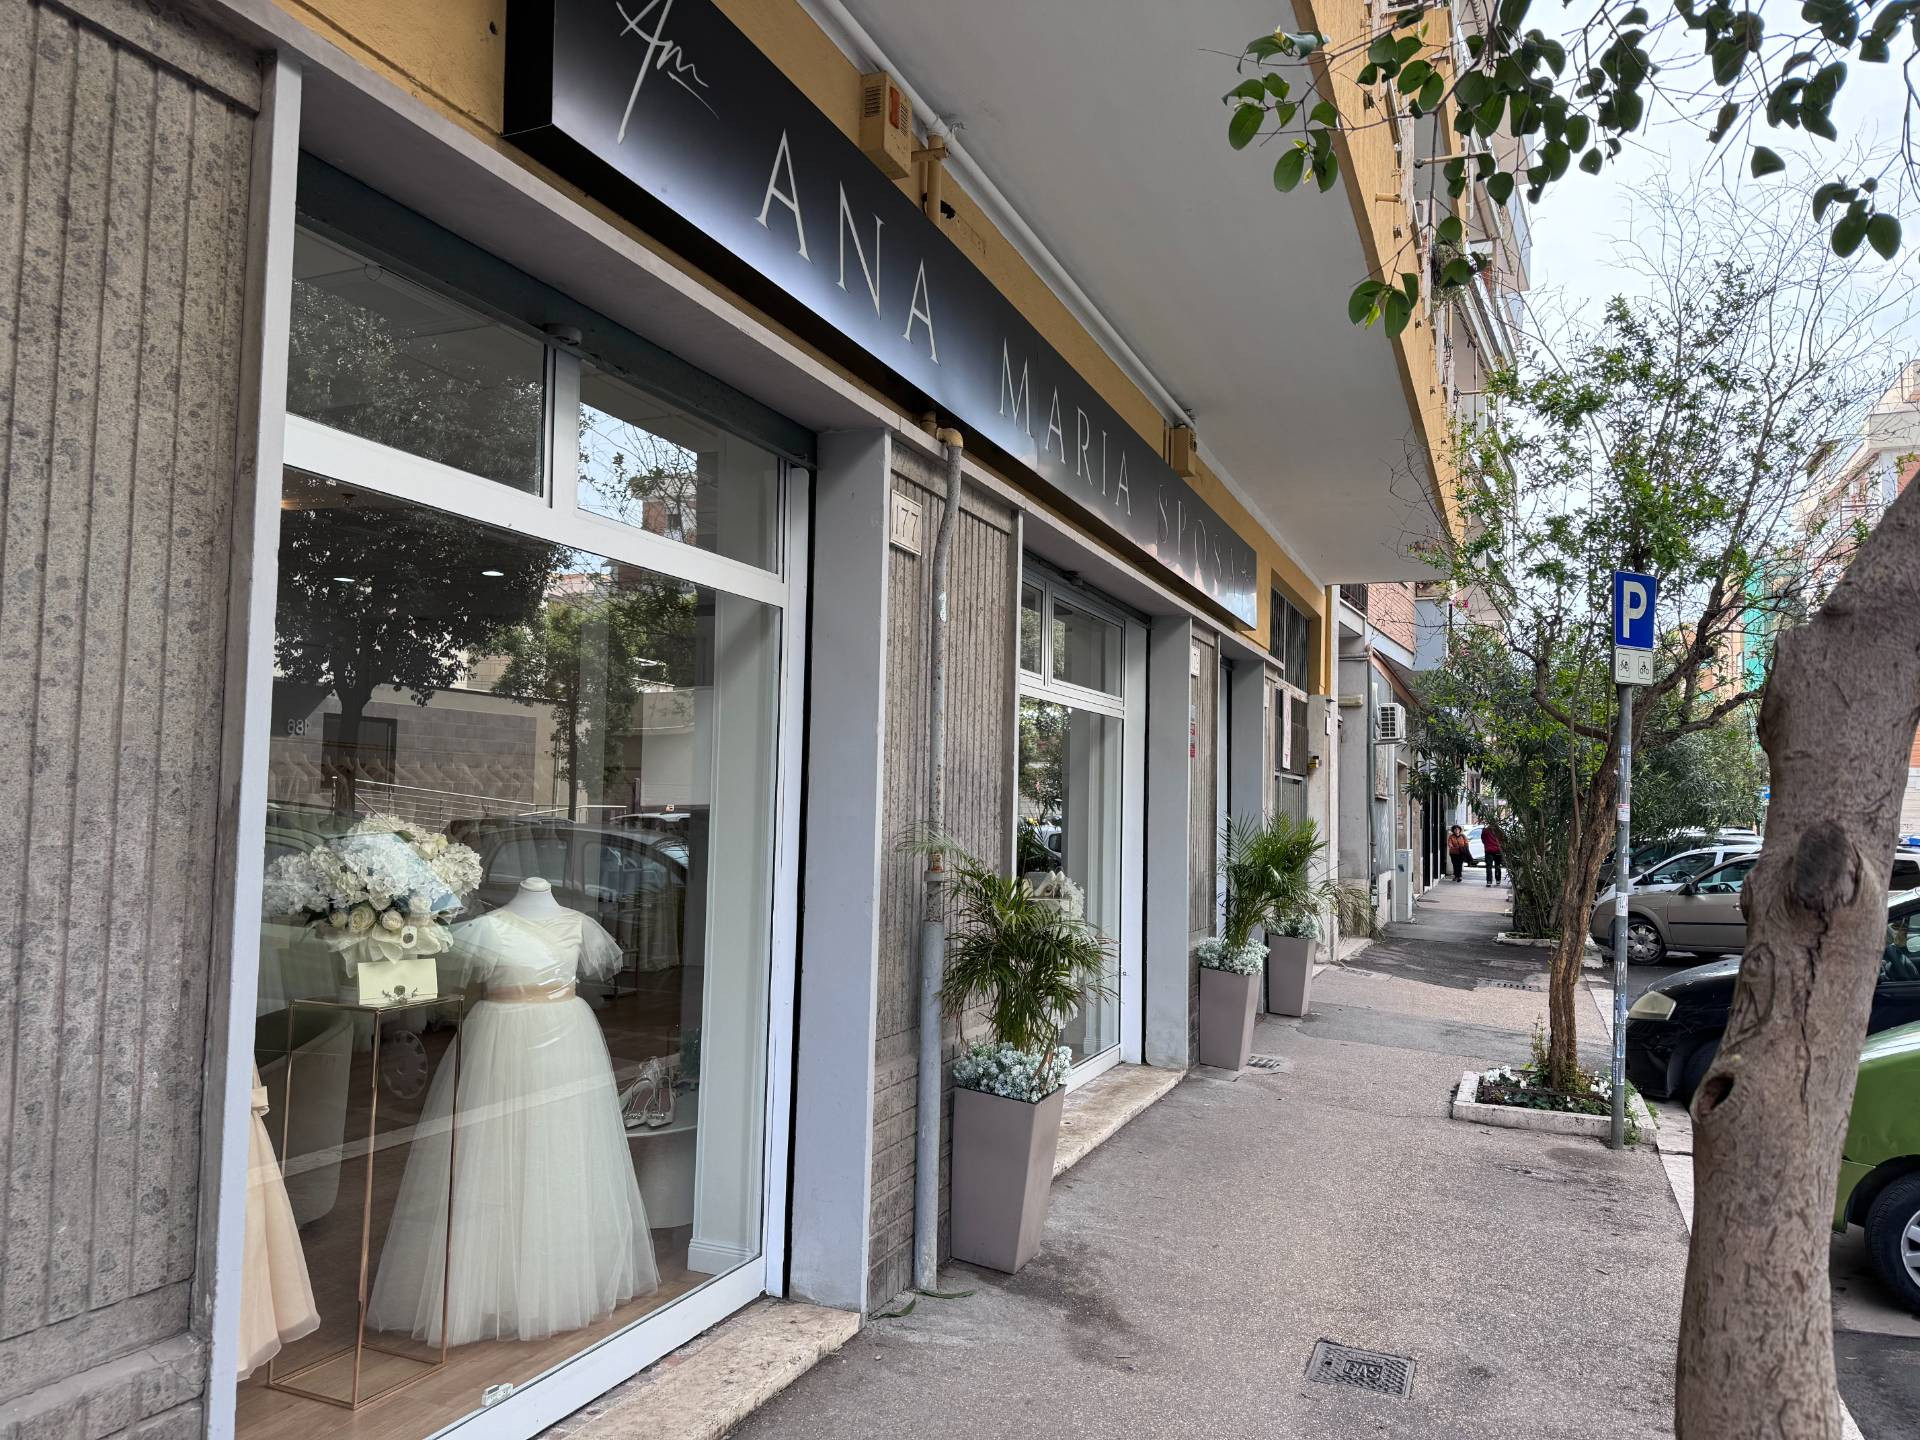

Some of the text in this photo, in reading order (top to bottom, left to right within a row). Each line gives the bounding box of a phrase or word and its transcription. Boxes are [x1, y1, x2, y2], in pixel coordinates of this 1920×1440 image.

[753, 128, 942, 367] ANA
[999, 336, 1132, 518] MARIA
[1622, 580, 1647, 639] P
[1346, 1361, 1381, 1379] GAS
